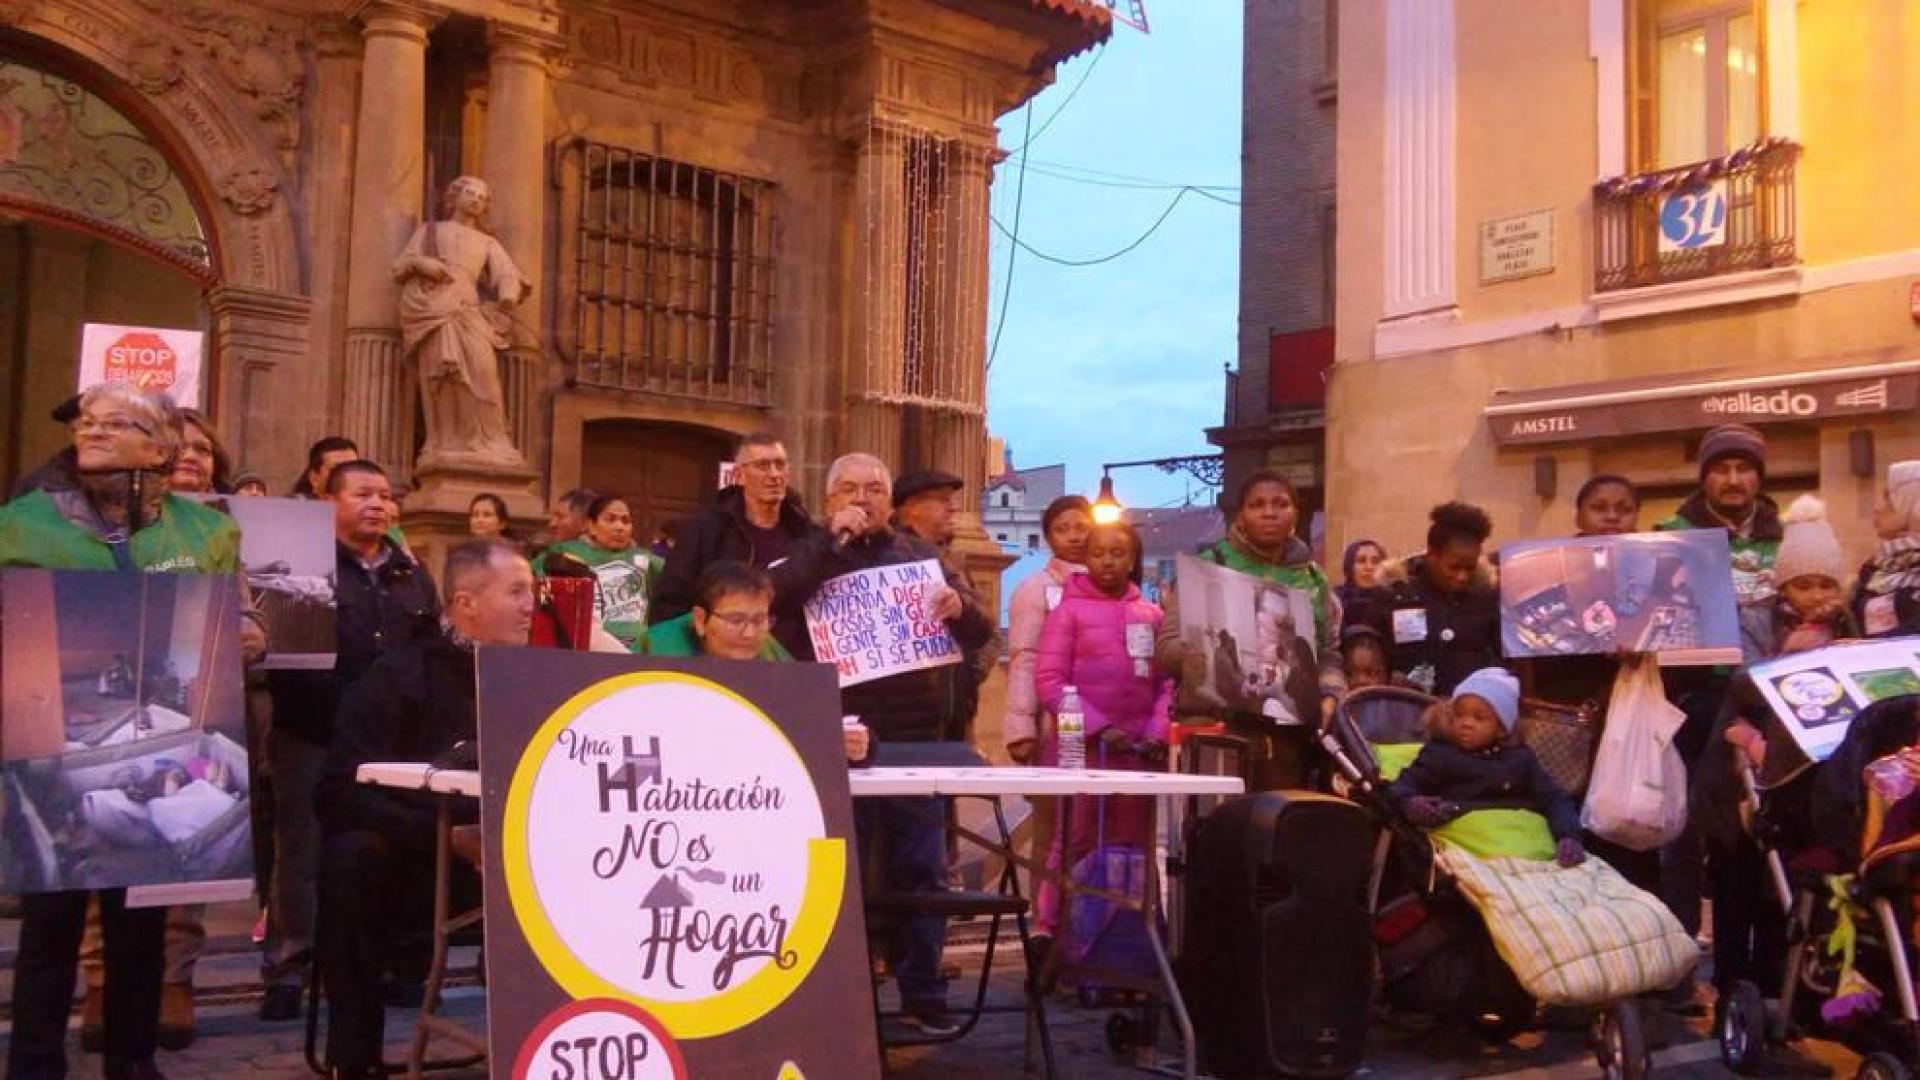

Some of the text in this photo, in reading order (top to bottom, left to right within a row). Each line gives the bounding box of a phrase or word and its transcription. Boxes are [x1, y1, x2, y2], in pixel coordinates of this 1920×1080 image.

[1677, 190, 1723, 246] 31
[110, 347, 172, 366] STOP
[1511, 415, 1576, 436] AMSTEL
[879, 571, 889, 588] A
[896, 565, 932, 583] UNA
[831, 611, 876, 637] CASAS
[880, 604, 904, 625] SIN
[836, 629, 882, 655] GENTE
[890, 623, 910, 644] SIN
[890, 642, 911, 665] SE
[558, 728, 614, 765] Una
[597, 737, 785, 813] Habitación
[592, 818, 713, 879] NO es
[732, 870, 764, 893] un
[638, 903, 798, 990] Hogar
[551, 1033, 648, 1080] STOP
